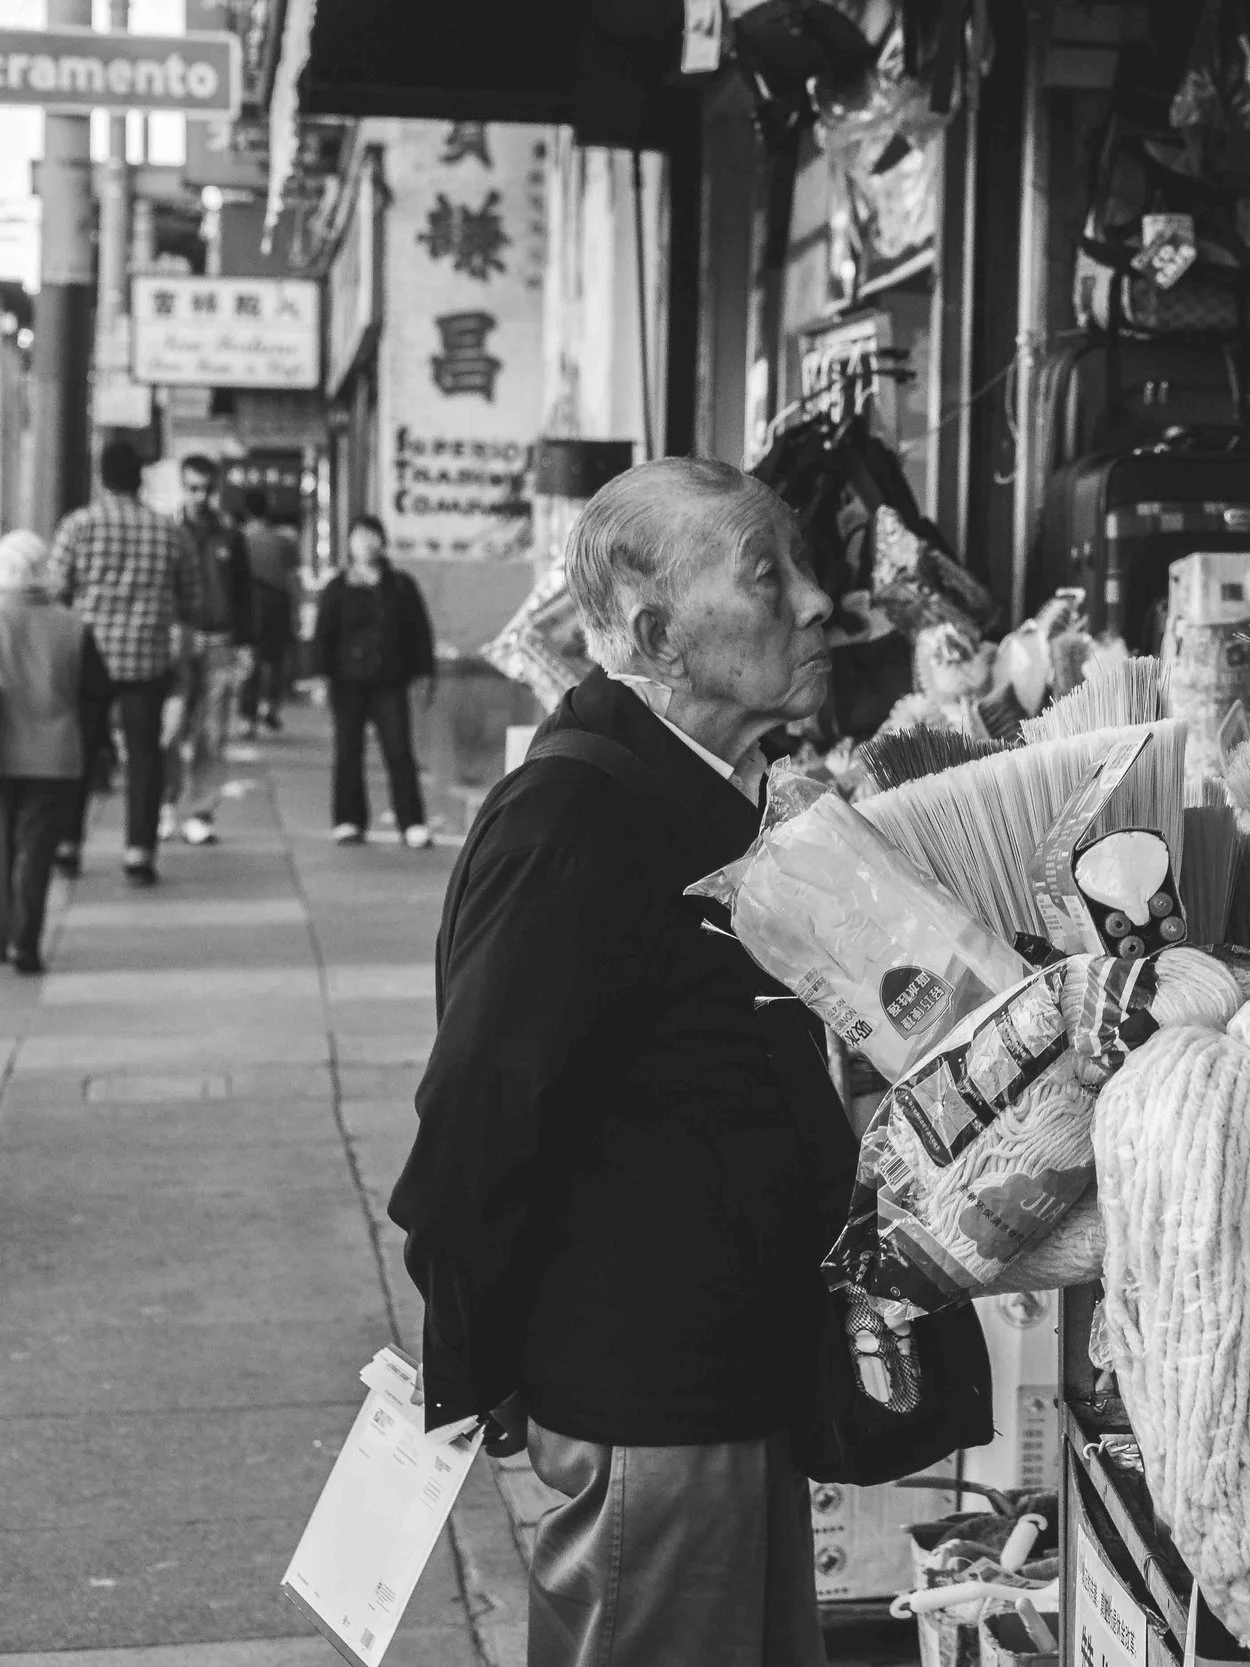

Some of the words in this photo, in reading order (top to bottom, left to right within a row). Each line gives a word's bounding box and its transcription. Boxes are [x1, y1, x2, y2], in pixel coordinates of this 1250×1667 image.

[0, 53, 218, 98] ramento
[885, 970, 931, 1017] 吸水性强
[898, 983, 945, 1032] 轻巧便捷
[841, 1018, 873, 1048] 吸水
